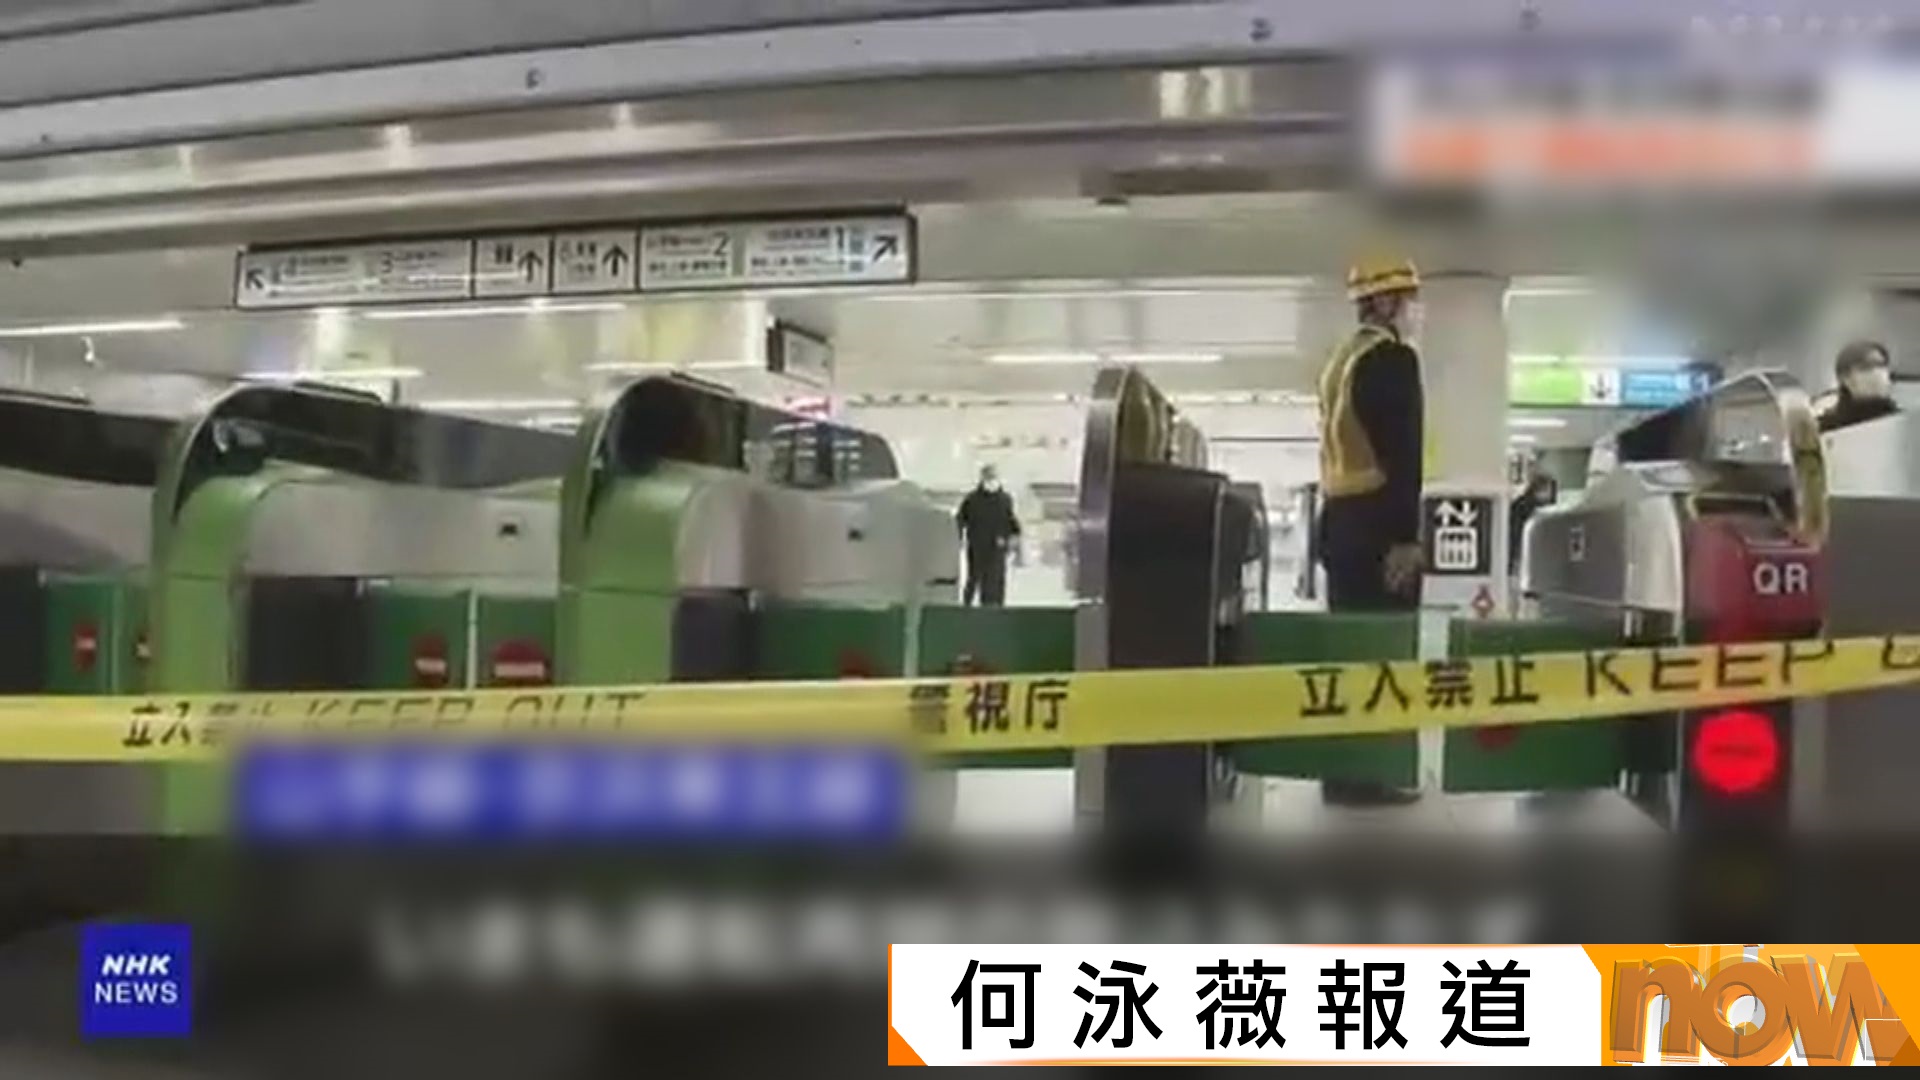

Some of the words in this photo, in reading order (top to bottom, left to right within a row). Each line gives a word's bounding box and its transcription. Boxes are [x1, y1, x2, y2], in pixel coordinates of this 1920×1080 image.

[713, 231, 730, 257] 2
[1753, 563, 1808, 594] QR
[1297, 656, 1539, 717] 立入禁止
